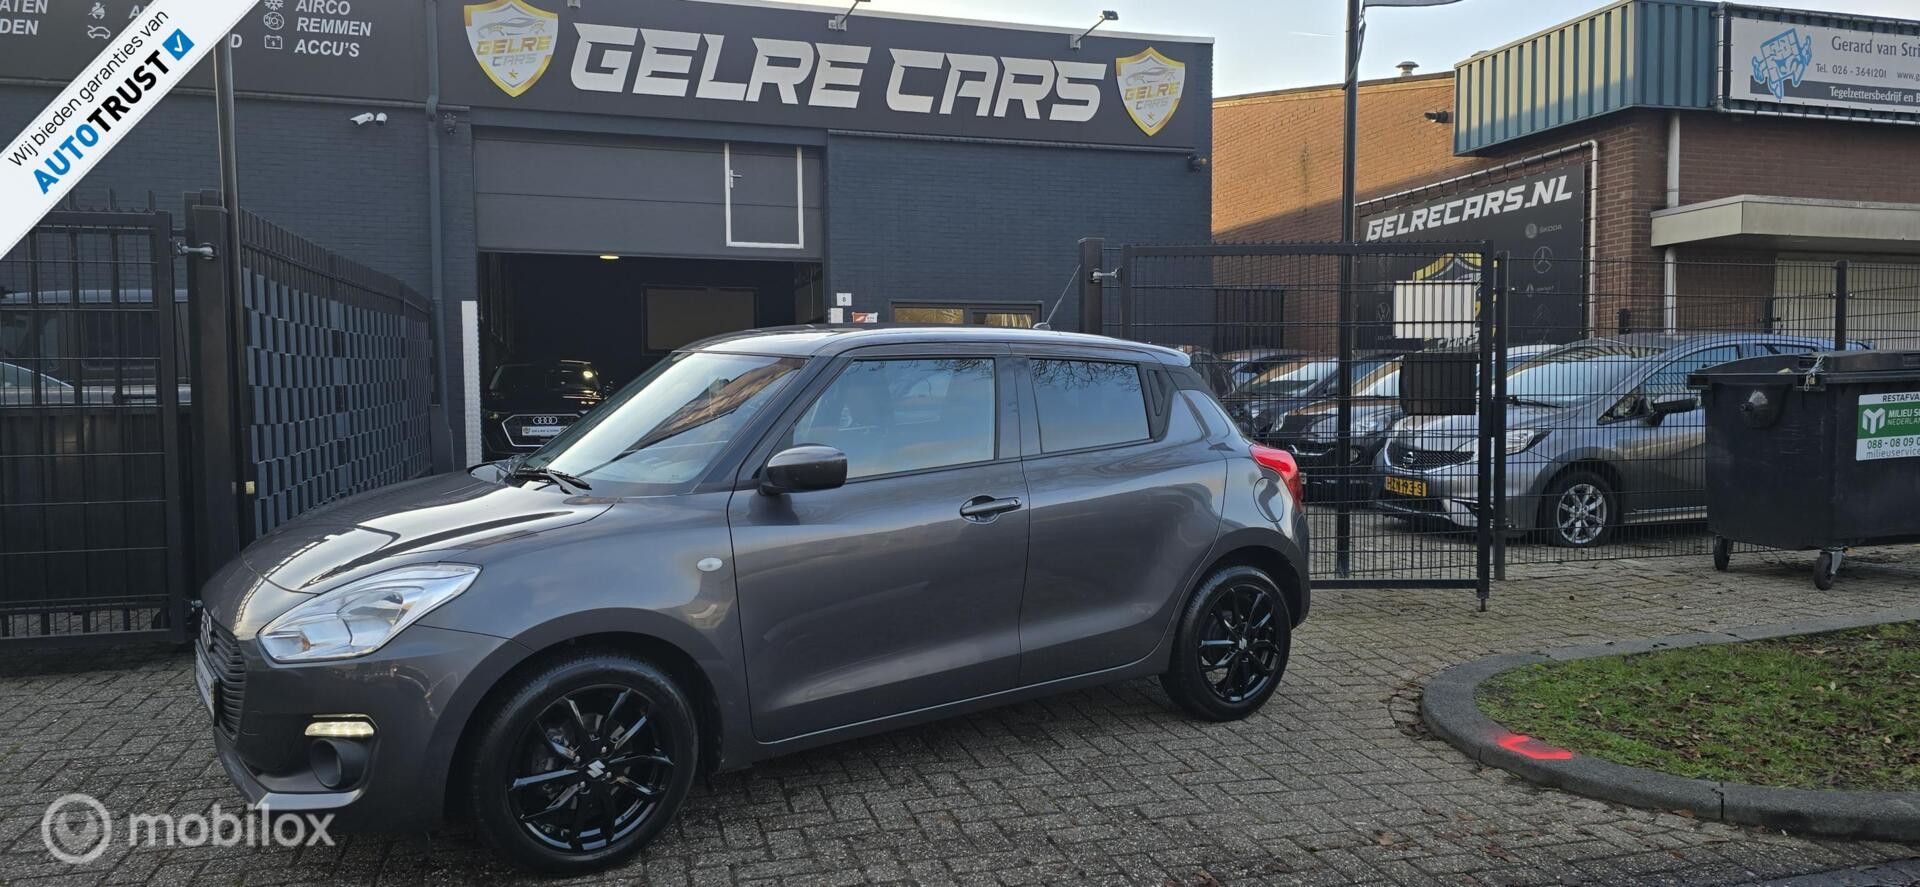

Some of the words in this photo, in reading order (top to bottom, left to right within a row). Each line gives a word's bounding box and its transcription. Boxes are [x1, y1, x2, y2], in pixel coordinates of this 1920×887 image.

[295, 0, 351, 15] AIRCO
[296, 16, 372, 37] REMMEN
[294, 38, 360, 58] ACCU'S
[477, 36, 552, 55] GELRE
[1831, 36, 1872, 53] Gerard
[1876, 43, 1897, 56] van
[492, 53, 536, 66] CARS
[571, 22, 872, 109] GELRE
[886, 48, 1107, 122] CARS
[1832, 64, 1848, 75] 026
[1856, 67, 1886, 78] 3641201
[1125, 82, 1180, 101] GELRE
[1829, 86, 1902, 102] Tegelzettersbedrijf
[1366, 174, 1573, 242] GELRECARS.NL
[1888, 409, 1912, 418] MILIEU
[1867, 440, 1882, 449] 088
[1890, 438, 1901, 448] 08
[1903, 436, 1914, 447] 09
